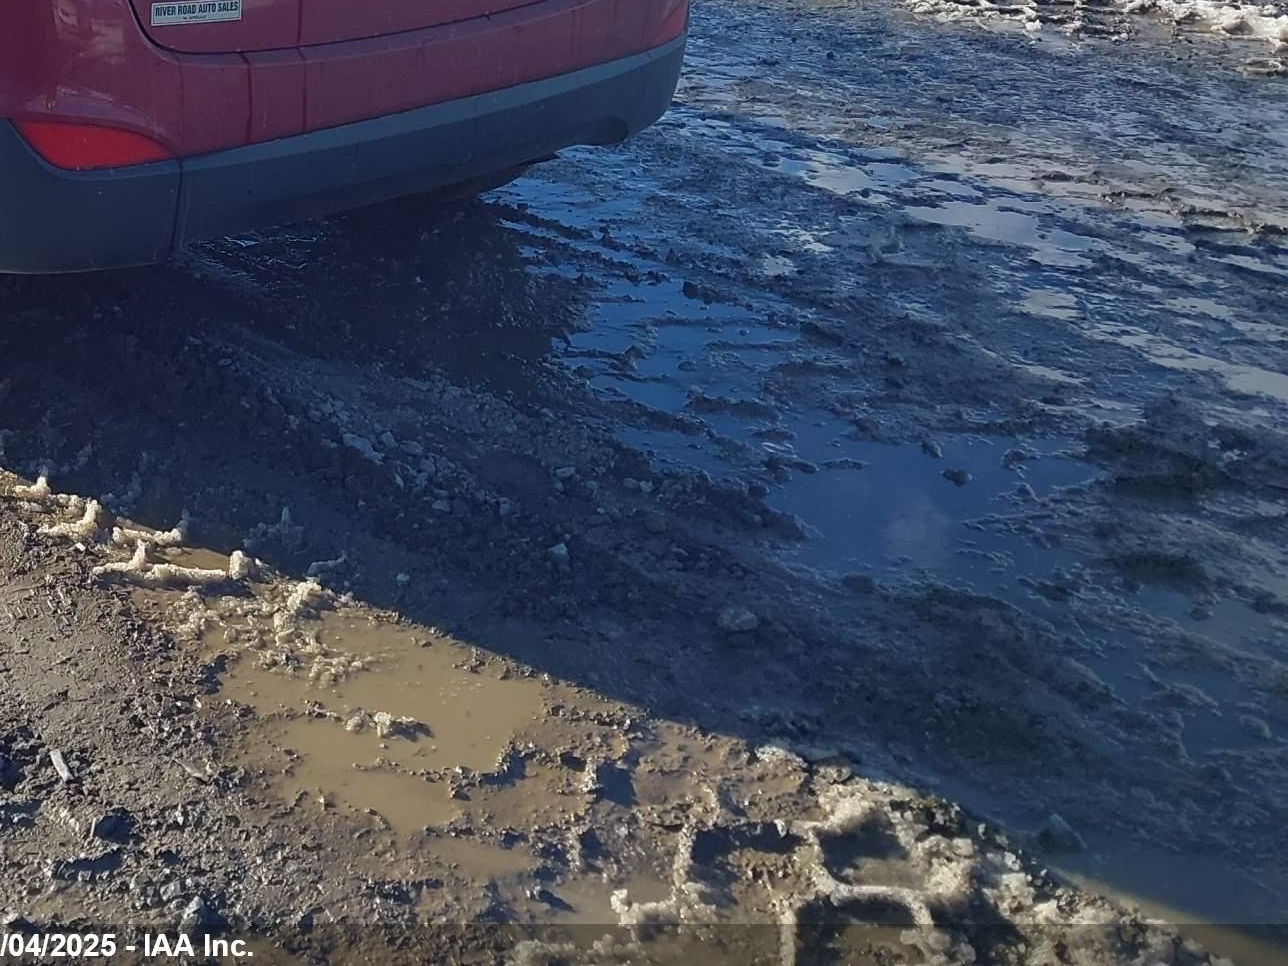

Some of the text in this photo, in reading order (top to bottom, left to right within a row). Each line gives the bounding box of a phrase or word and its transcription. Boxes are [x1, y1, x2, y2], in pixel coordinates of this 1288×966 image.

[155, 1, 239, 17] RIVER ROAD AUTO SALES
